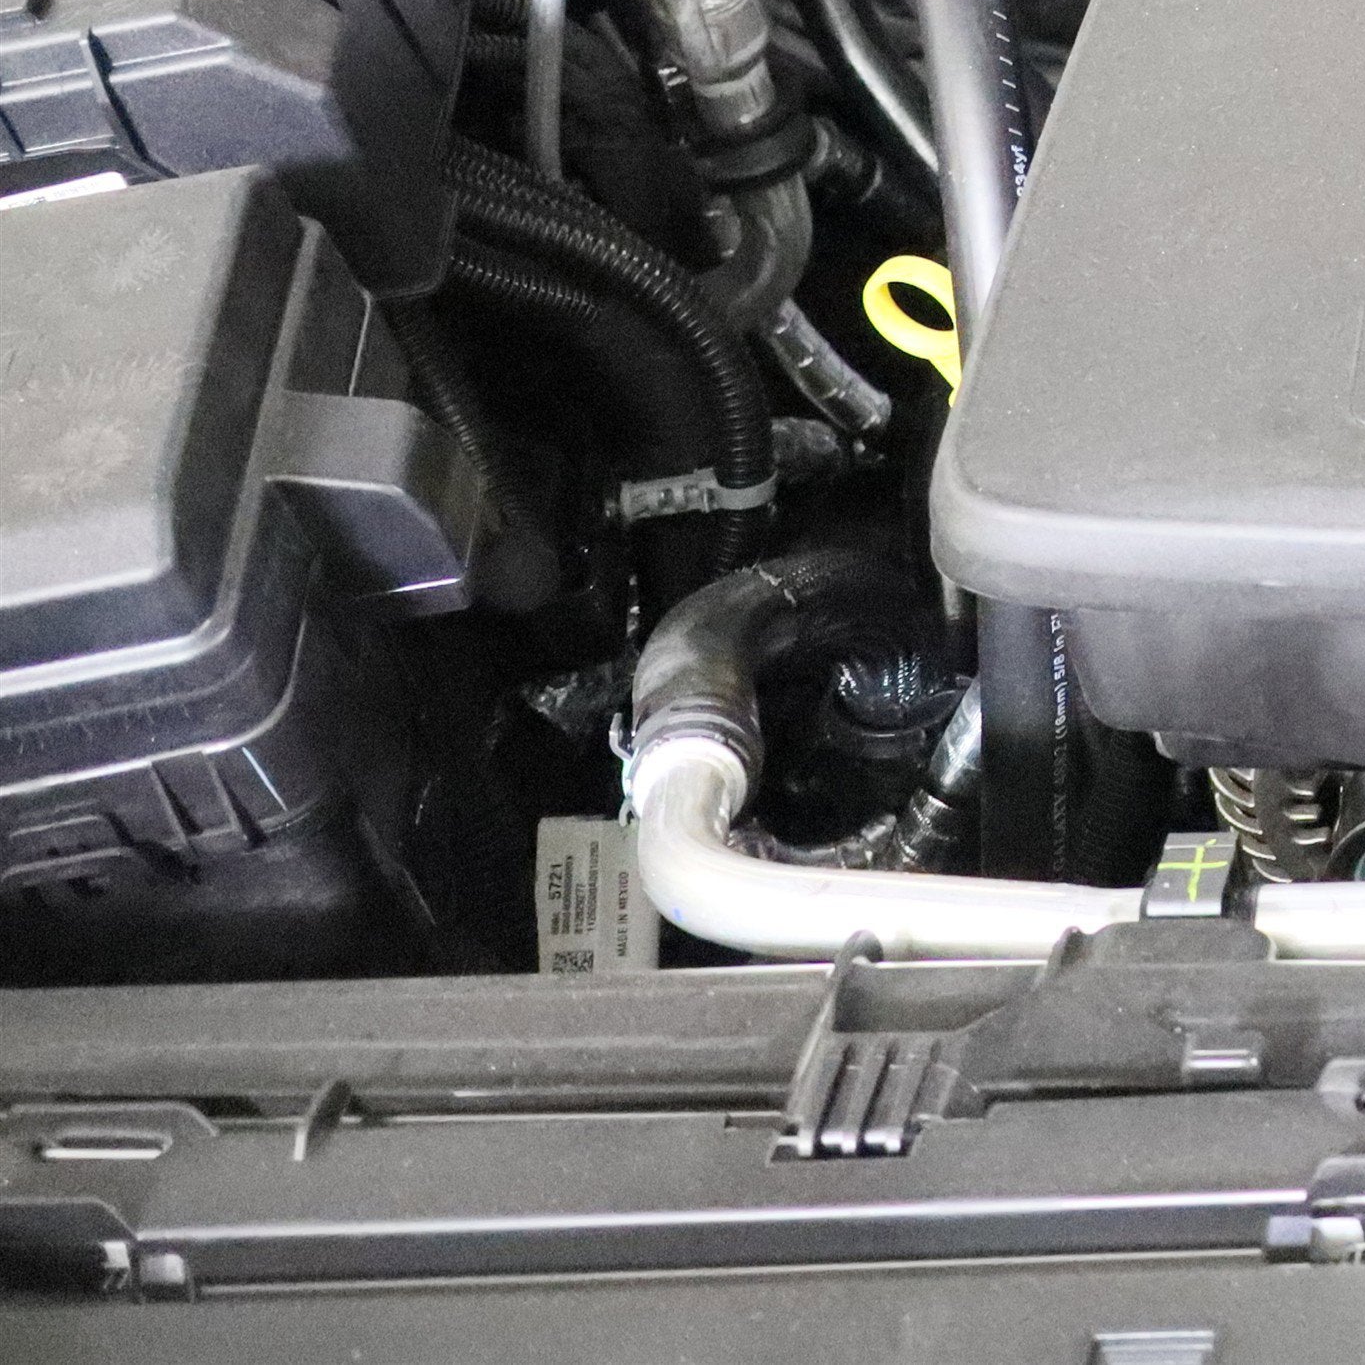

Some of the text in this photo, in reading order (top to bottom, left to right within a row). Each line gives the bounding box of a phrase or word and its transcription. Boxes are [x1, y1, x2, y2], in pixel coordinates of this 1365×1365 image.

[1053, 681, 1068, 740] (16mm)
[548, 863, 563, 901] 5721
[616, 871, 630, 957] MADE IN MEXICO
